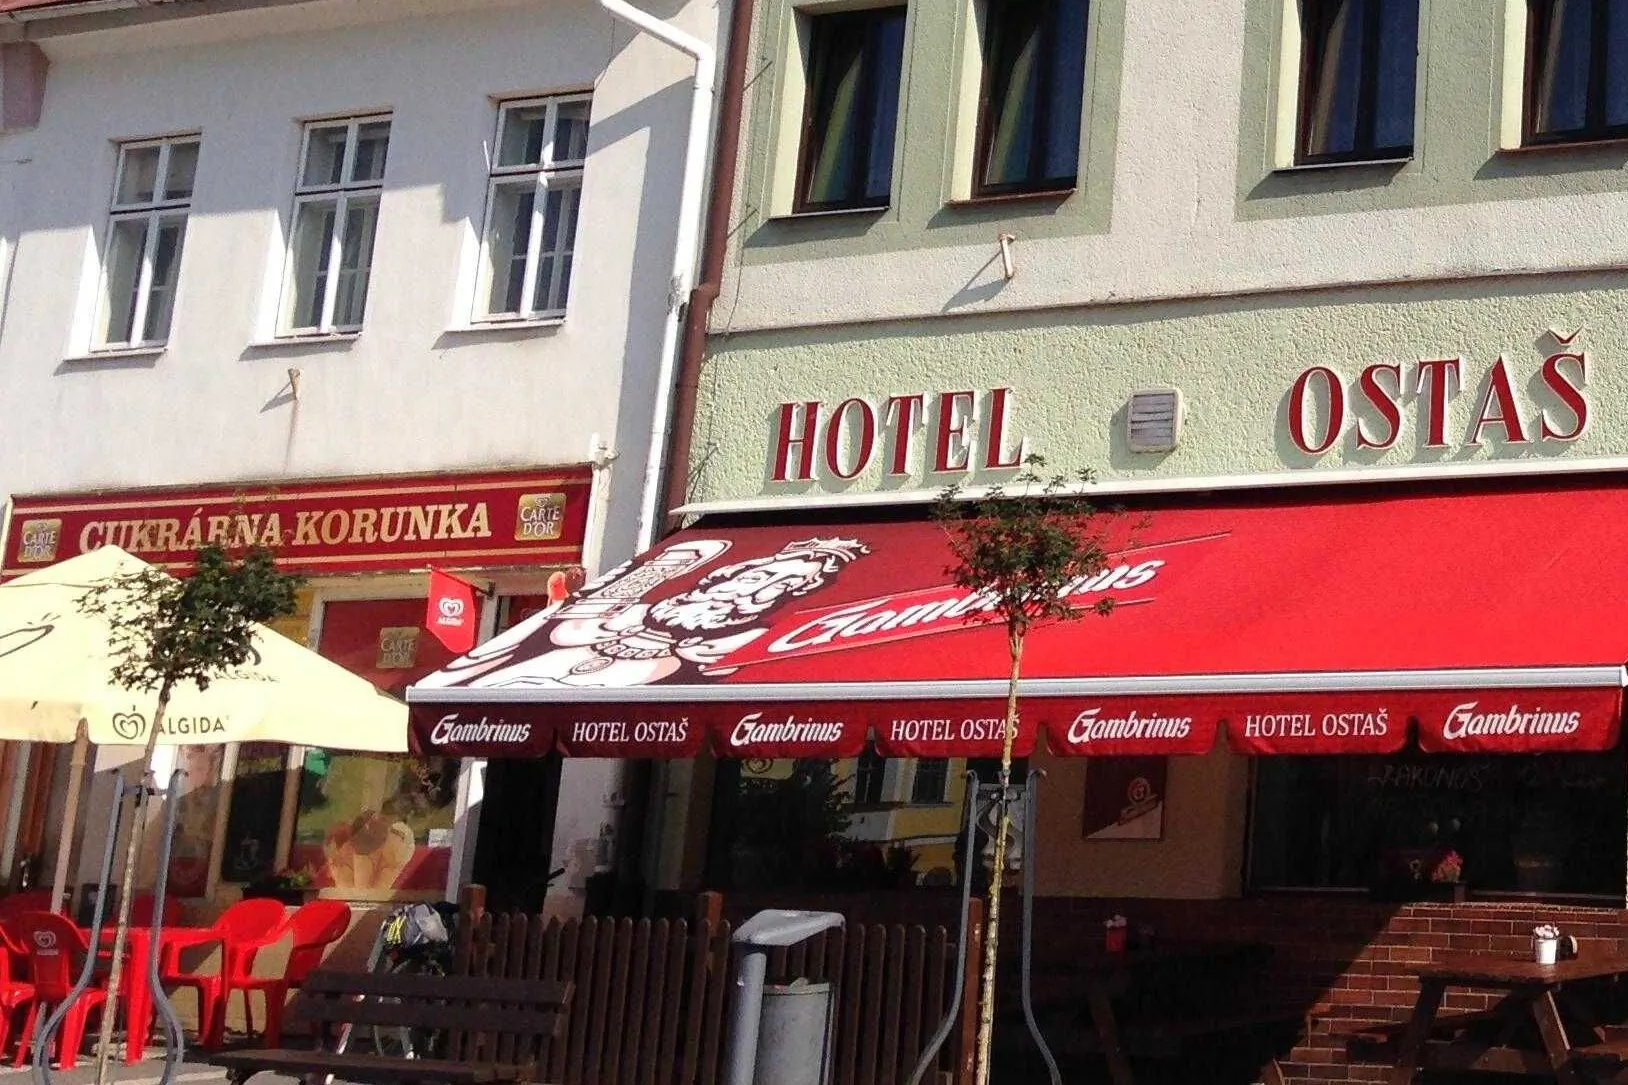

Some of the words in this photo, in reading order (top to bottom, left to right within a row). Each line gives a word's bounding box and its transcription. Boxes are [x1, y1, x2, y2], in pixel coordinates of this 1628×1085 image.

[770, 387, 1024, 483] HOTEL
[1286, 326, 1592, 456] OSTAŠ
[79, 507, 284, 553] CUKRÁRNA
[291, 502, 492, 545] KORUNKA
[520, 506, 560, 524] CARTE
[523, 522, 555, 538] D'OR
[768, 560, 1166, 653] Gambus
[157, 716, 225, 735] ALGIDA
[430, 713, 531, 745] Gambrinus
[572, 721, 629, 742] HOTEL
[634, 717, 689, 742] OSTAŠ
[730, 712, 843, 747] Gambrinus
[891, 719, 954, 742] HOTEL
[1067, 707, 1191, 744] Gambrinus
[1245, 713, 1316, 738] HOTEL
[1322, 707, 1388, 737] OSTAŠ
[1443, 701, 1581, 739] Gambrinus
